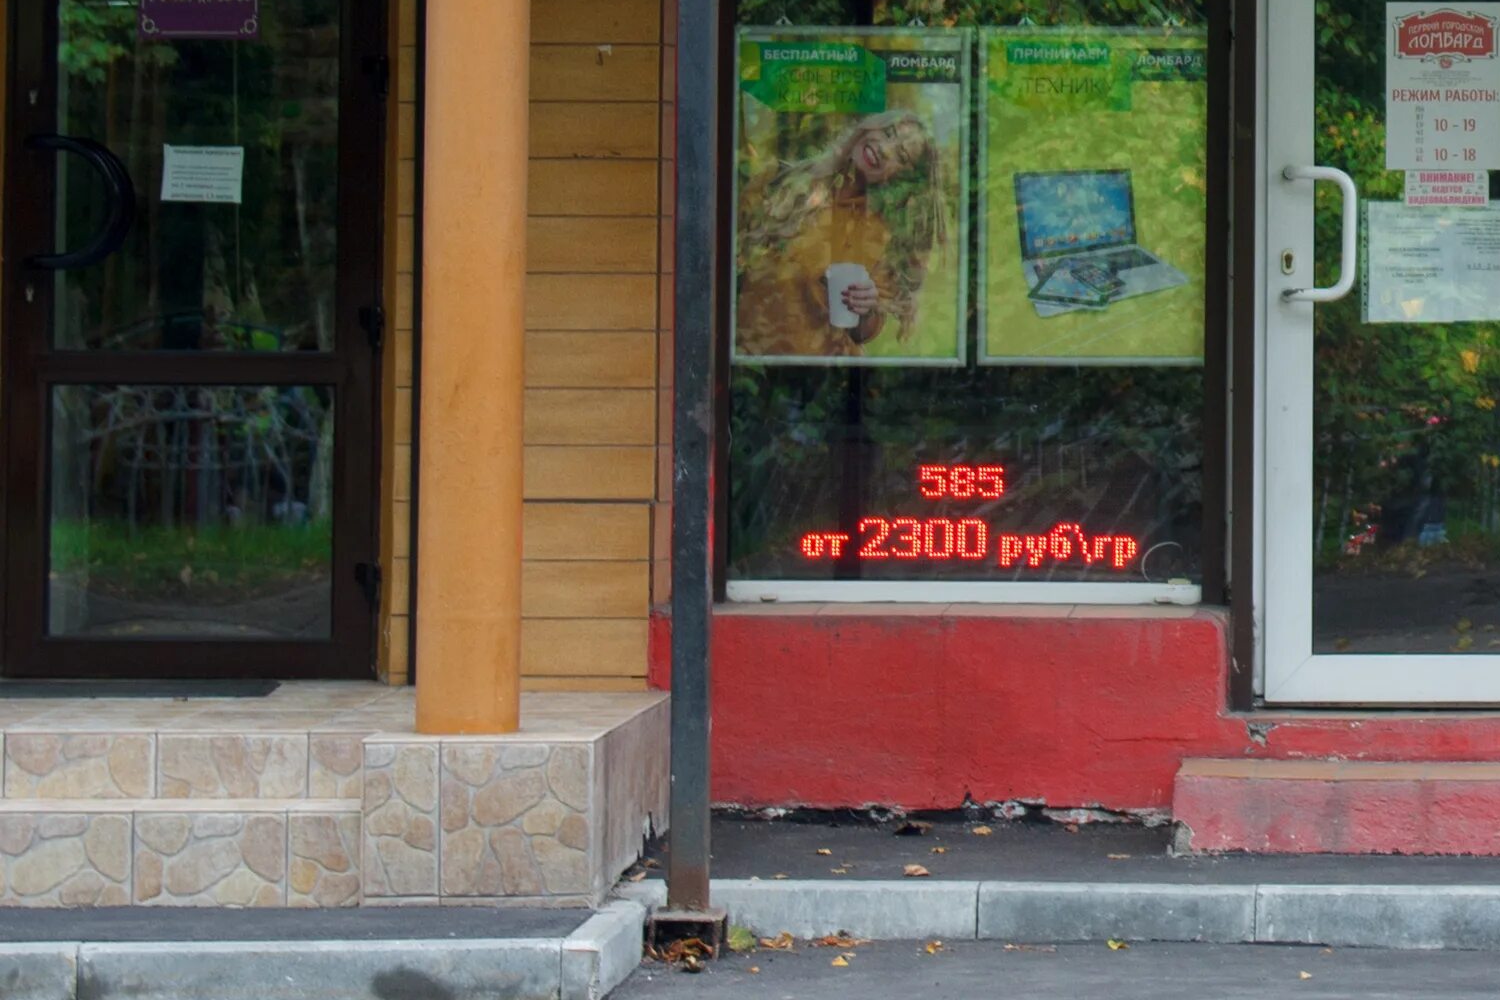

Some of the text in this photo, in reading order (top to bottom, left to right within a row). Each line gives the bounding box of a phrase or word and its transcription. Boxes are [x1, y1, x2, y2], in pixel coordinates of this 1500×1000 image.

[1408, 31, 1484, 49] ЛОМБАРД
[763, 48, 859, 62] БЕСПЛАТНЫЙ
[1136, 54, 1202, 67] ЛОМБАРД
[891, 56, 956, 69] ЛОМБАРД
[1392, 88, 1500, 102] РЕЖИМ РАБОТЫ:
[1434, 118, 1448, 132] 10
[1463, 118, 1476, 132] 19
[1434, 148, 1448, 161] 10
[1463, 148, 1477, 161] 18
[919, 464, 1005, 498] 585
[801, 530, 849, 558] от
[858, 517, 989, 560] 2300
